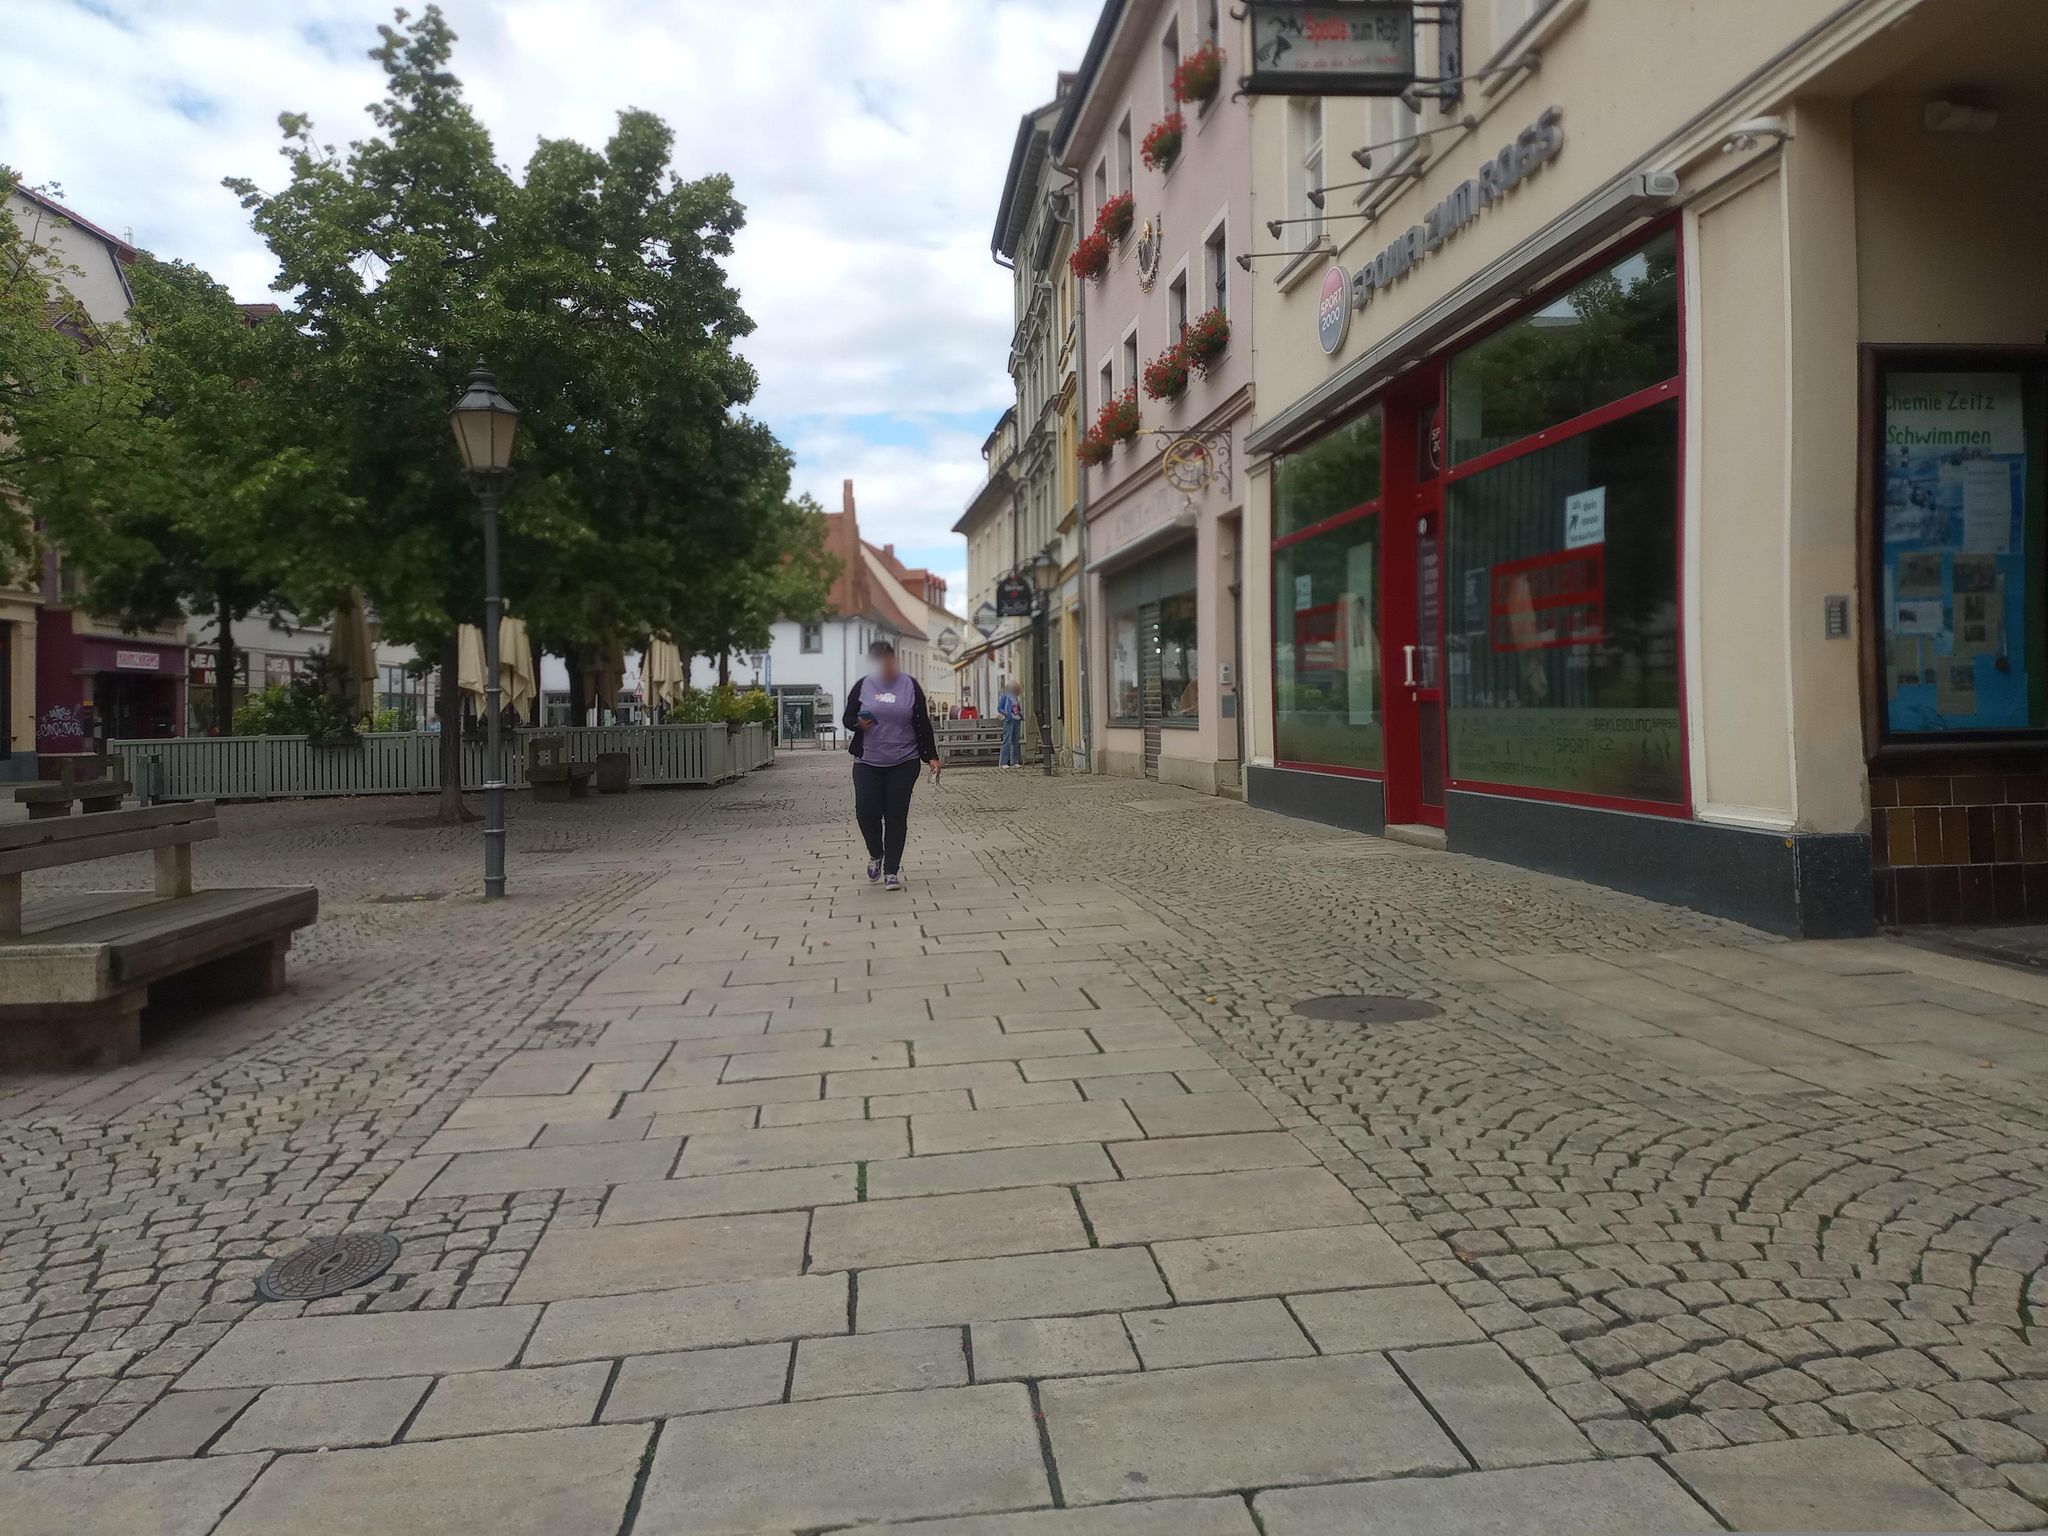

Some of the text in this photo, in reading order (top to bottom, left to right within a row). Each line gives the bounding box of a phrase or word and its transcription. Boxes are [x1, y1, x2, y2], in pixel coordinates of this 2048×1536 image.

[1424, 179, 1480, 252] ZUM
[1479, 105, 1565, 208] ROSS
[1320, 286, 1343, 316] SPORT
[1321, 306, 1341, 332] 2000
[1947, 390, 1995, 411] Zeitz
[1886, 424, 1991, 445] Schwimmen
[190, 653, 241, 671] JEA
[1556, 737, 1589, 754] SPORT
